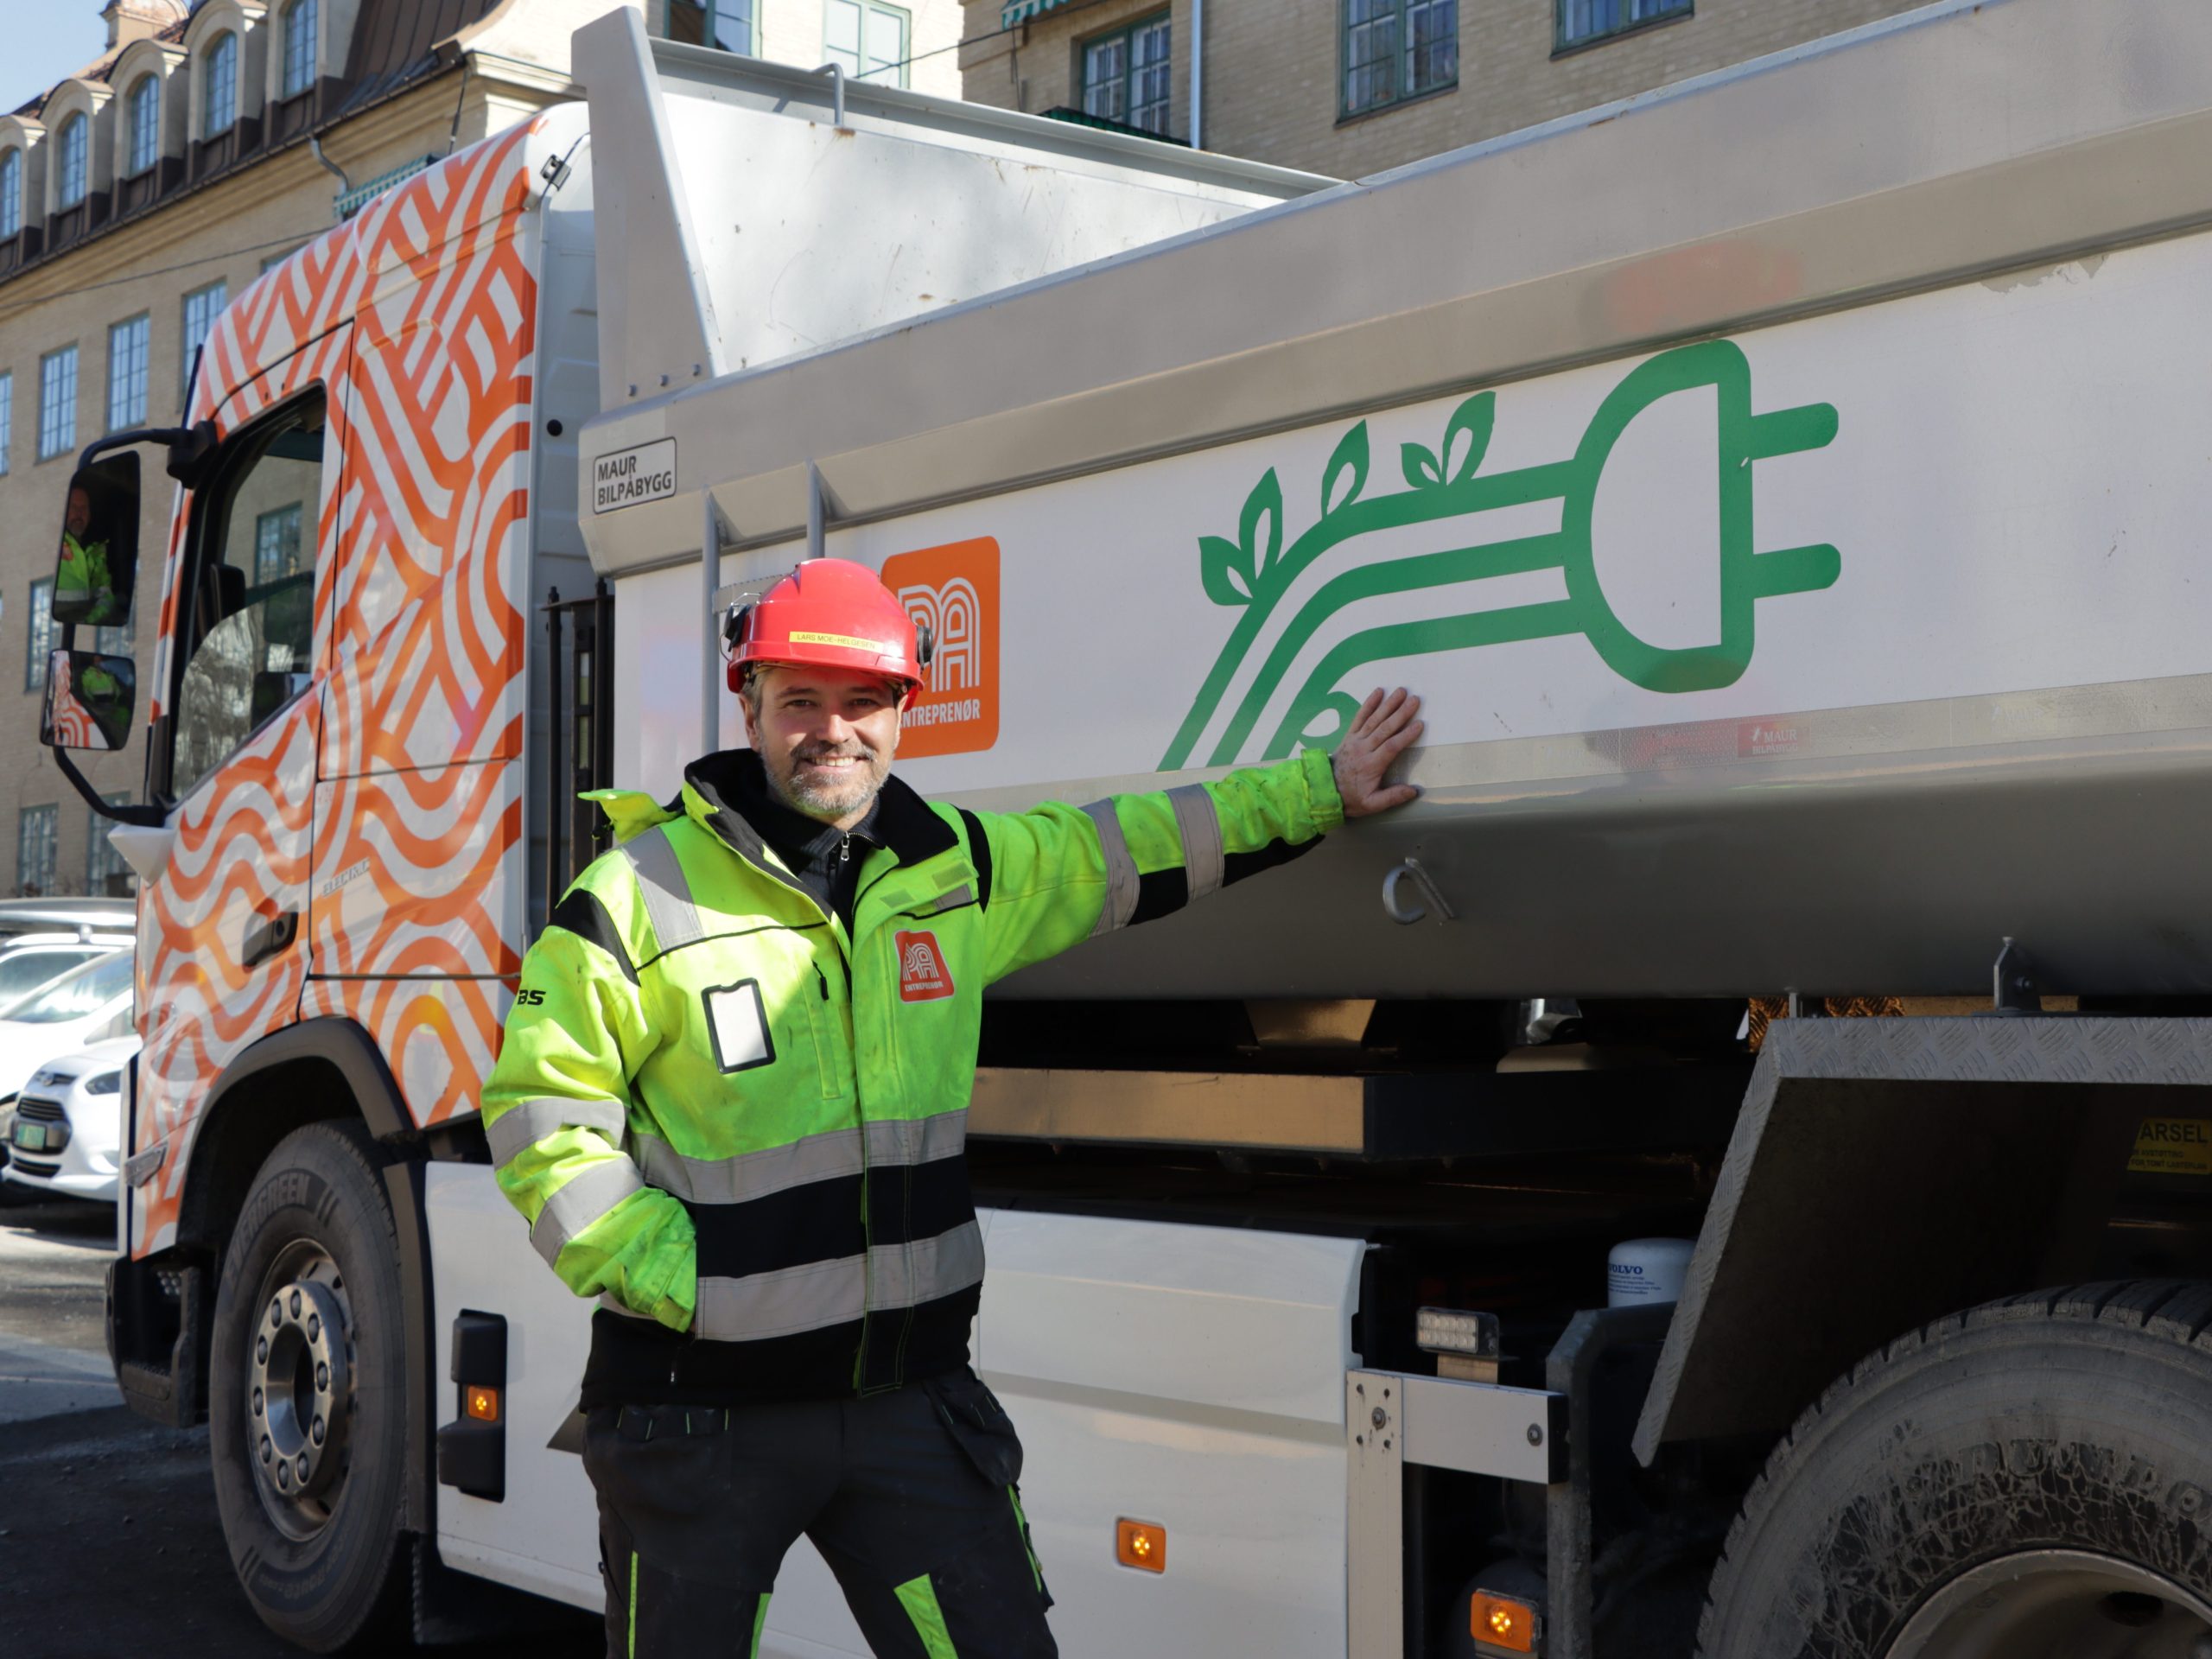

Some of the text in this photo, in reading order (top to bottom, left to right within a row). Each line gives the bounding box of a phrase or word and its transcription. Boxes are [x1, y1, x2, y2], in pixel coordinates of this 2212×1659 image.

[598, 455, 636, 481] MAUR
[598, 470, 671, 505] BILPÅBYGG
[899, 698, 980, 728] NTREPRENØR
[1764, 728, 1797, 743] MAUR
[2139, 1122, 2209, 1143] ARSEL
